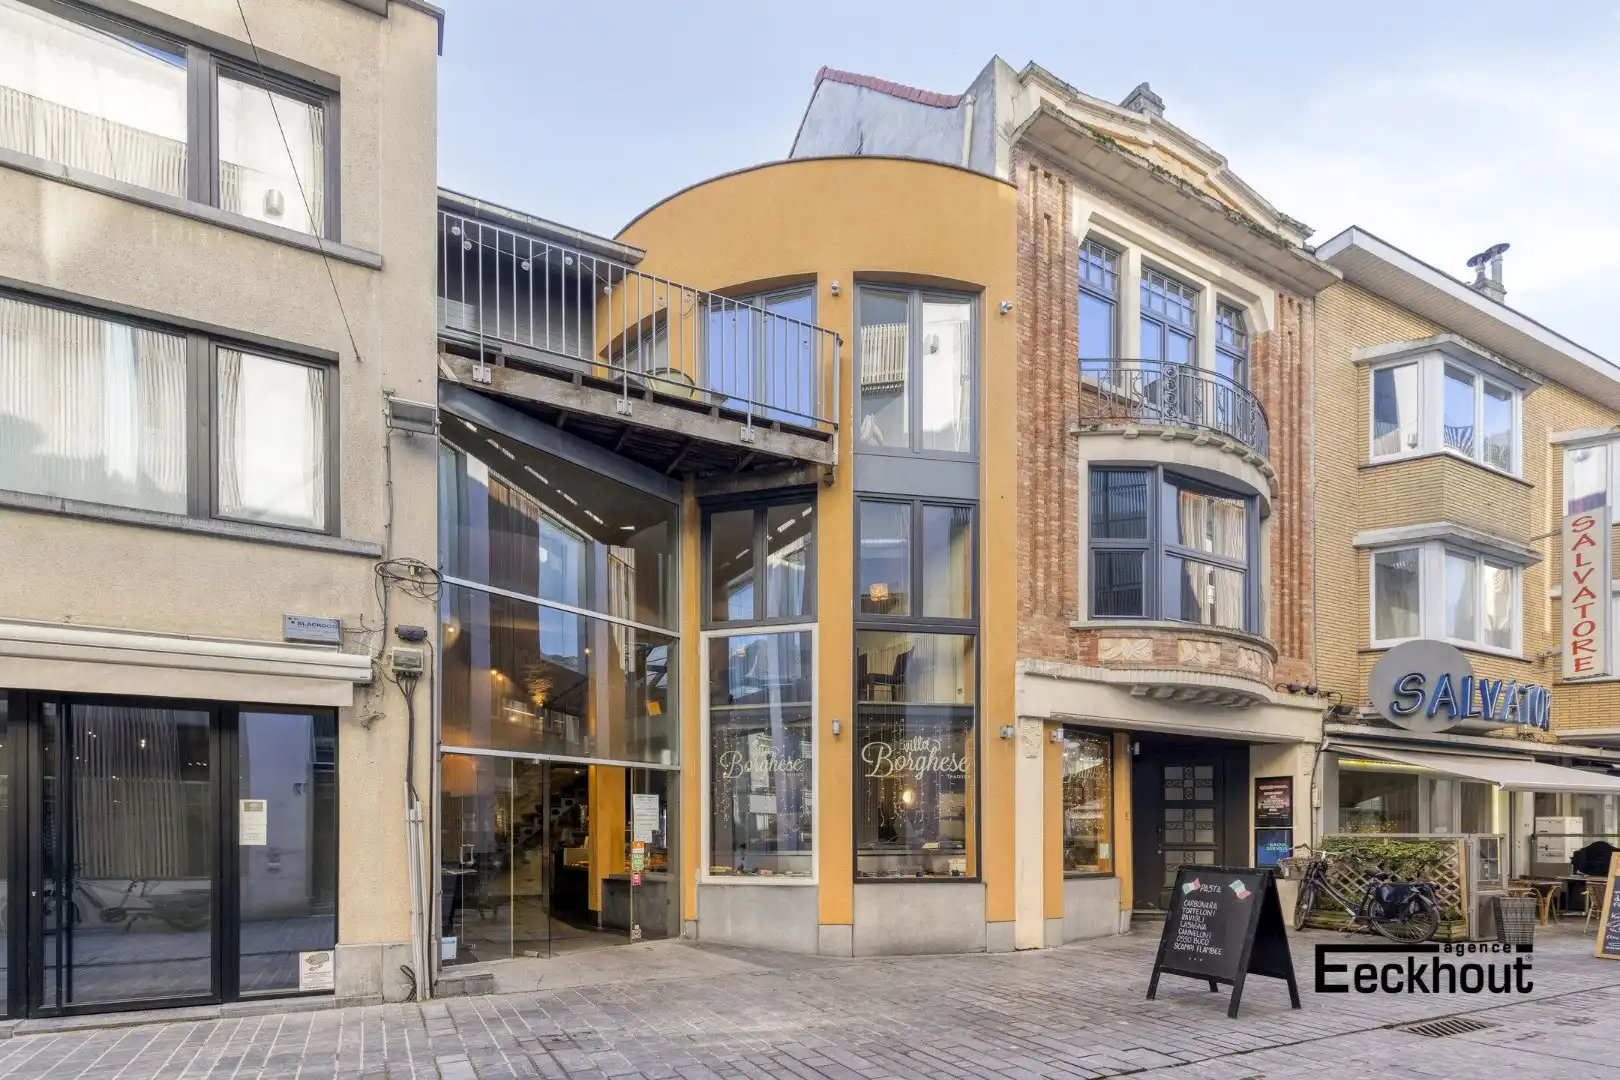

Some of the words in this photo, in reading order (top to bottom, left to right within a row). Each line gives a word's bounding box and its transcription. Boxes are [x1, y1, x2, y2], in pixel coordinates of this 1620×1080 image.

[1571, 515, 1597, 673] SALVATORE
[902, 735, 941, 753] villa
[861, 741, 971, 780] Borghese
[1200, 884, 1221, 892] PASTA
